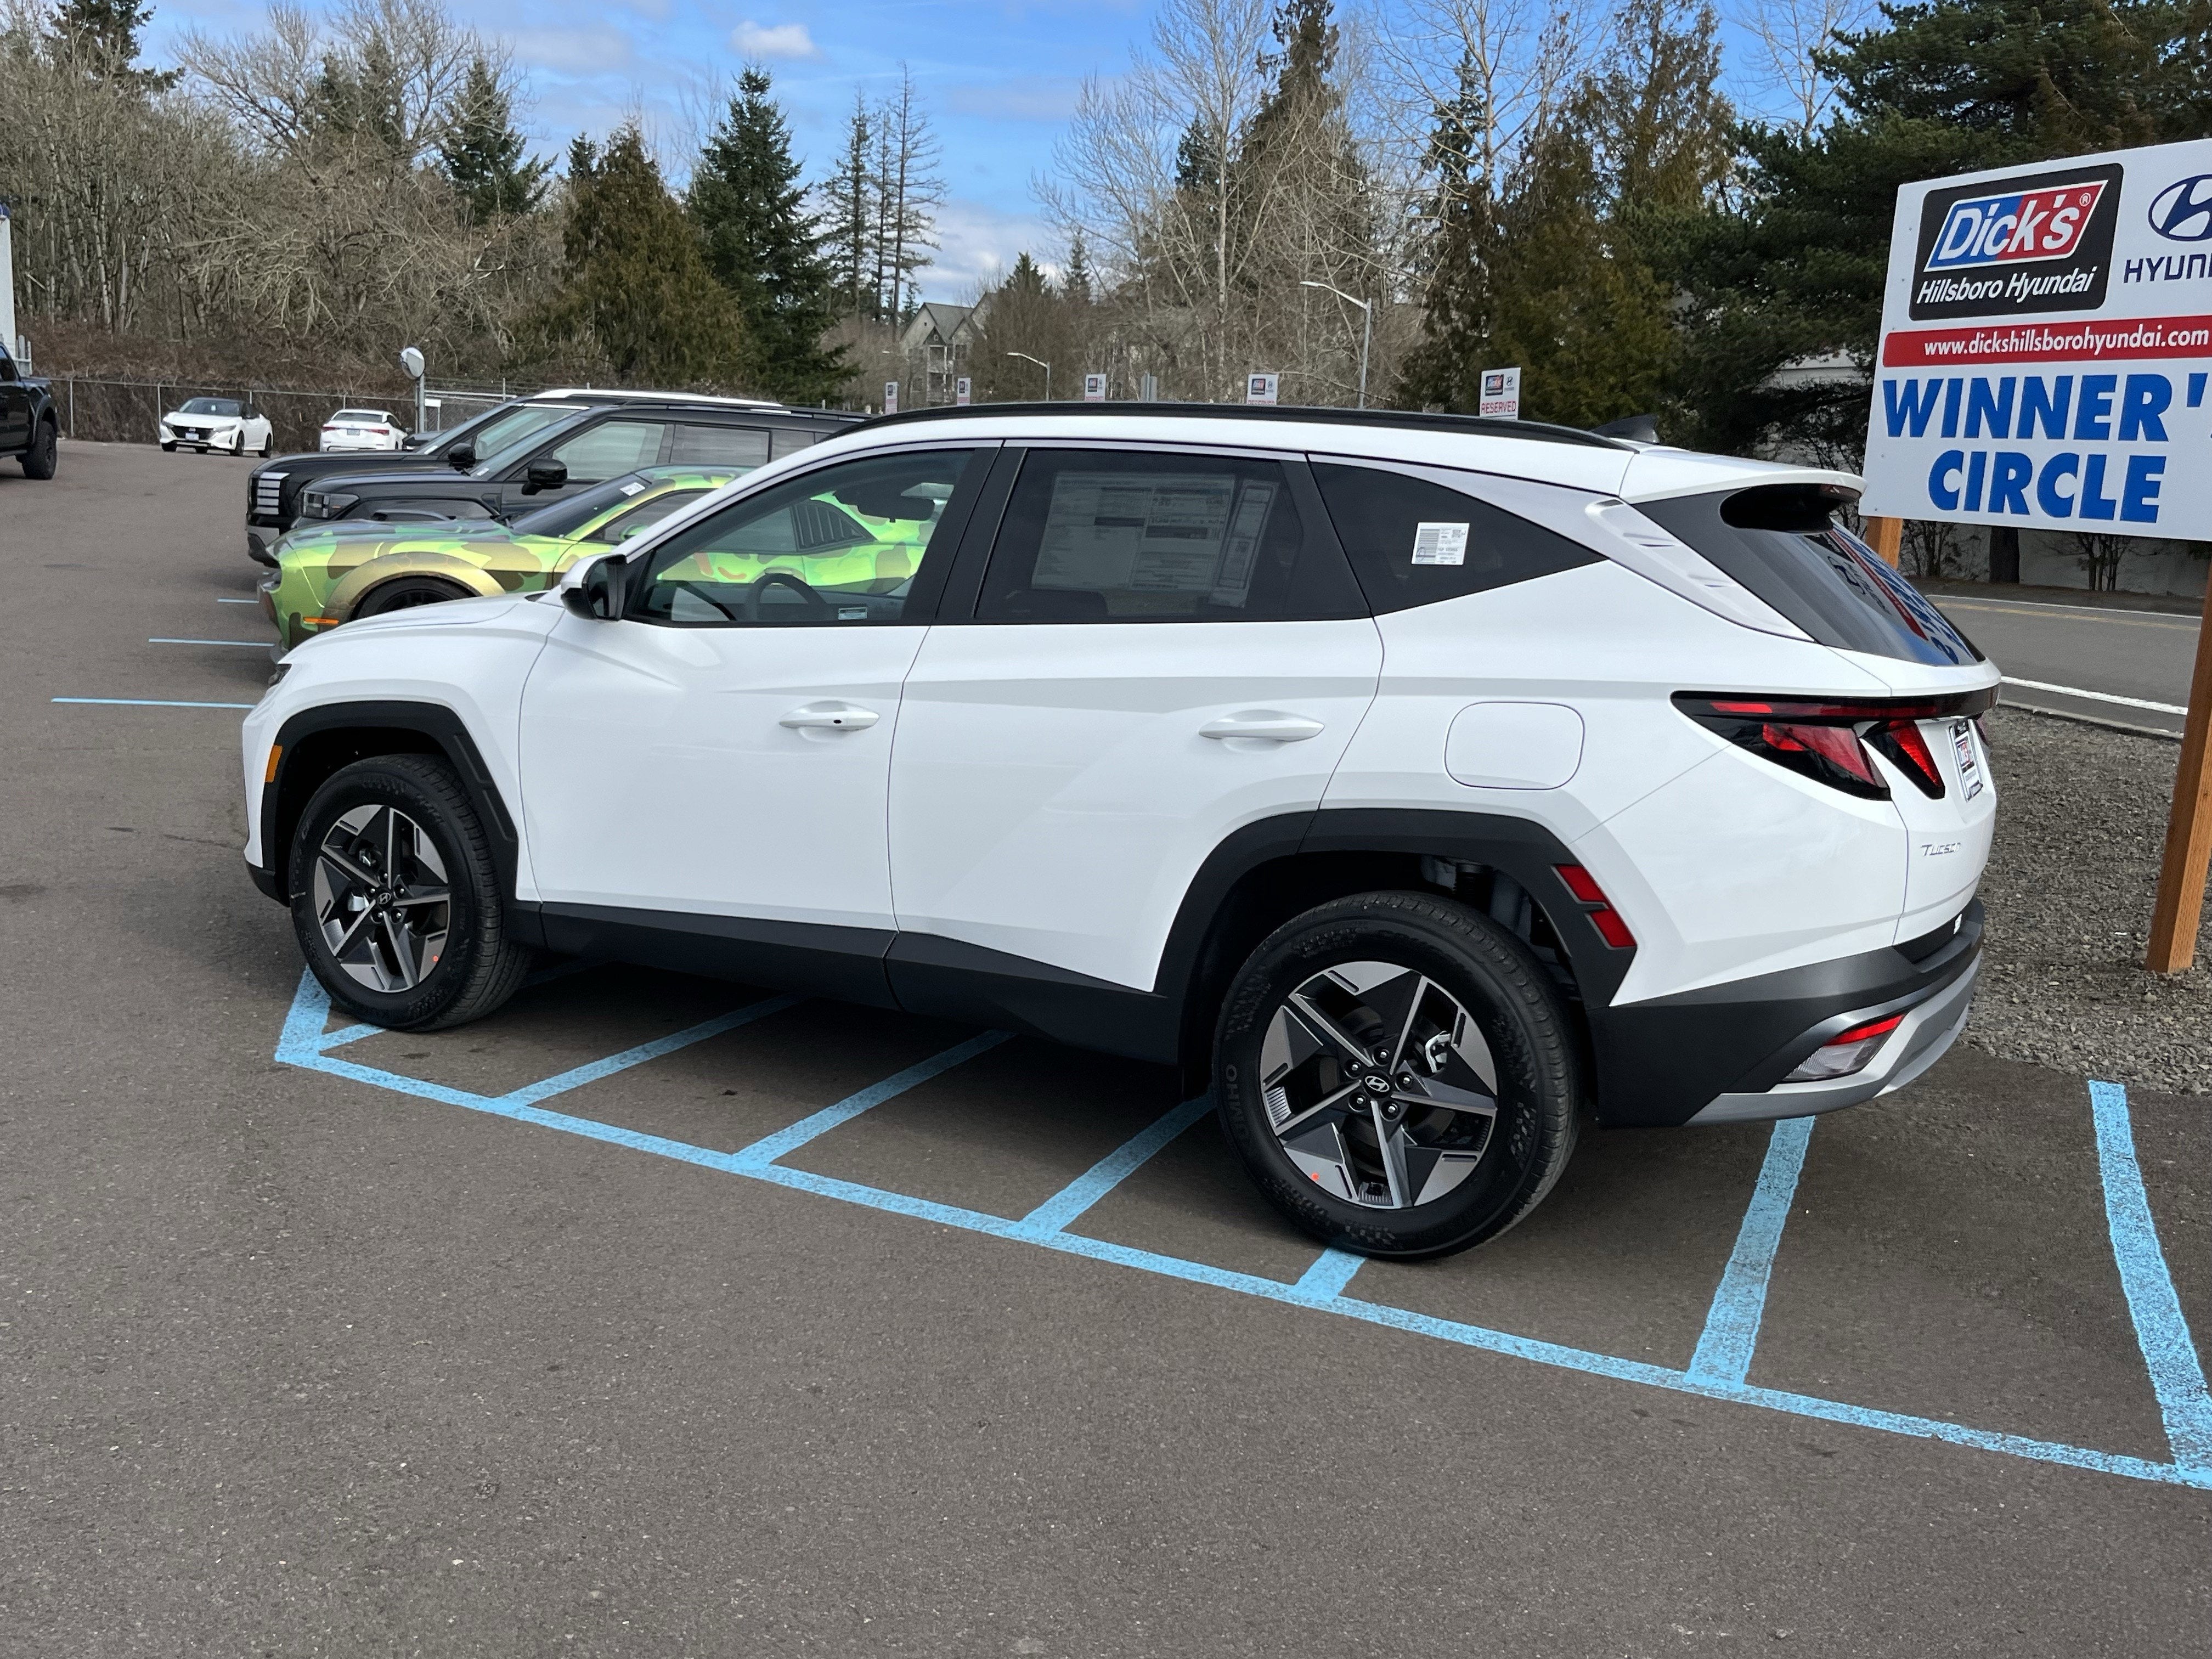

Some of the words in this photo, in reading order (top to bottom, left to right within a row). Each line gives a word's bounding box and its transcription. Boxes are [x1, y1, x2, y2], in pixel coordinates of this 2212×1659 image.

[1916, 277, 2002, 304] Hillsboro
[2005, 267, 2097, 303] Hyundai
[1924, 324, 2209, 356] www.dickshillsborohyundai.com
[1481, 400, 1516, 414] RESERVED
[1882, 372, 2212, 442] WINNER'
[1928, 450, 2166, 523] CIRCLE
